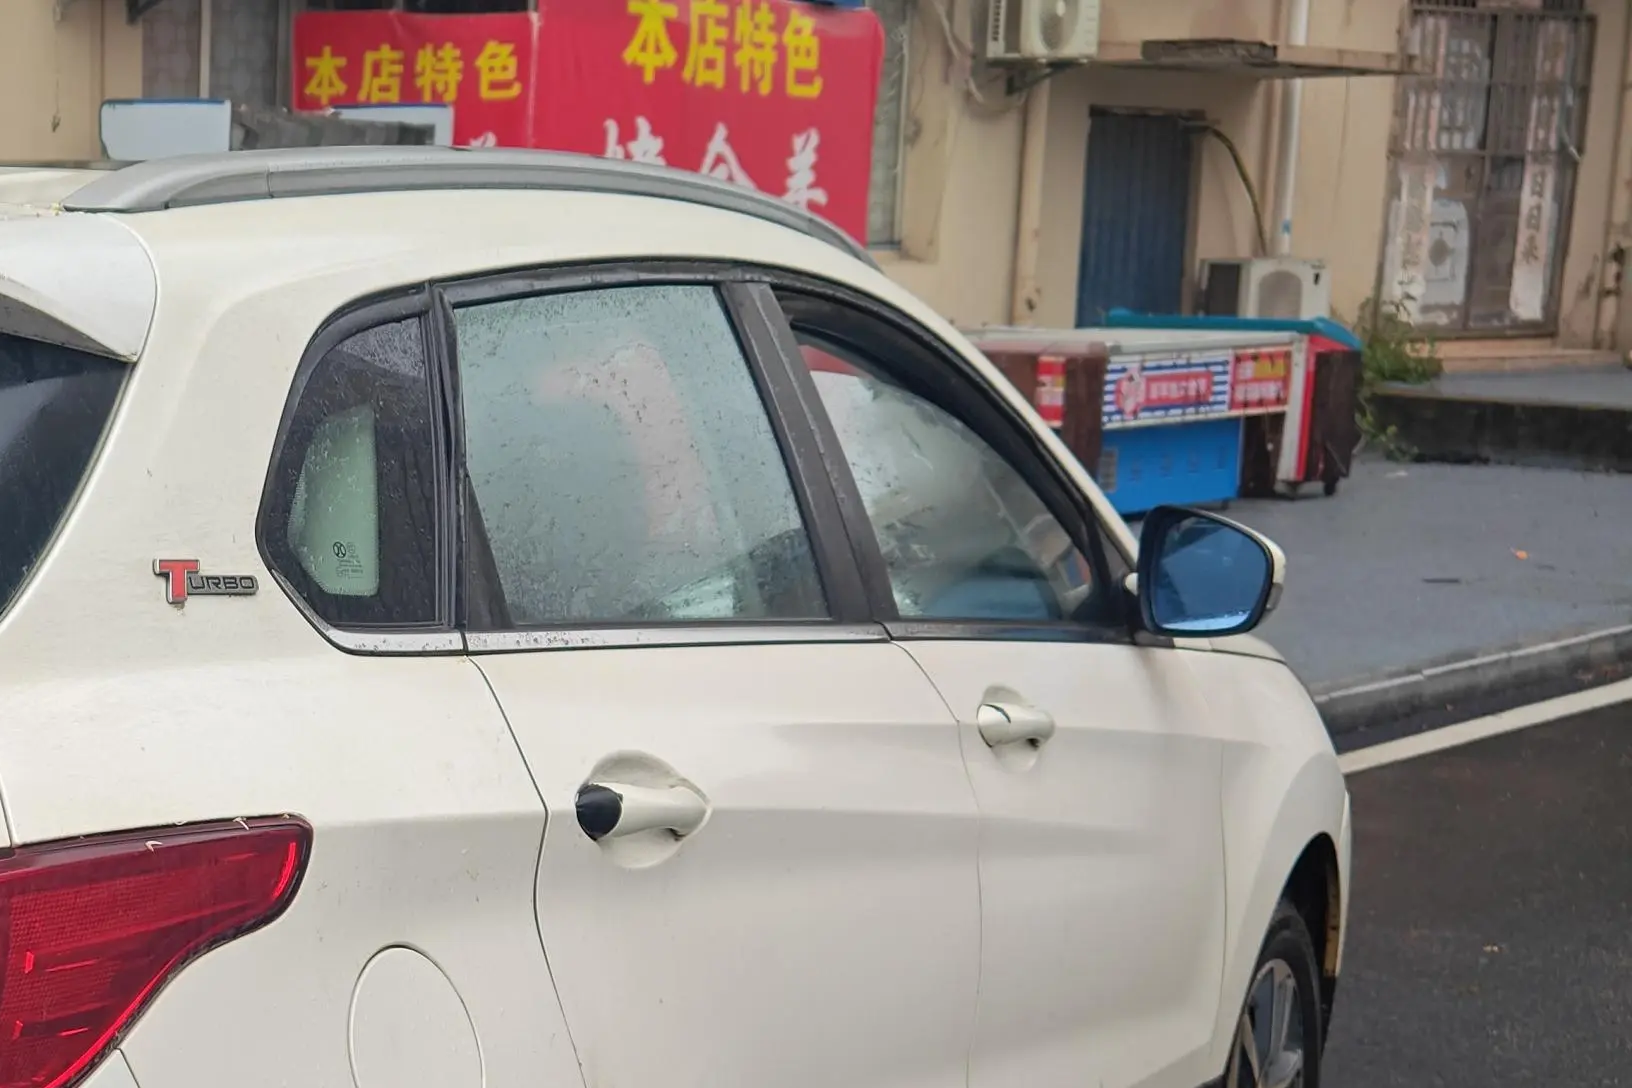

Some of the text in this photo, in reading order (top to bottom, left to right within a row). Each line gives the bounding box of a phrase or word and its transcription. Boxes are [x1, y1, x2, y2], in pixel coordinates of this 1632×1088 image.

[303, 39, 524, 105] 本店特色
[622, 0, 824, 99] 本店特色
[152, 558, 258, 605] TURBO
